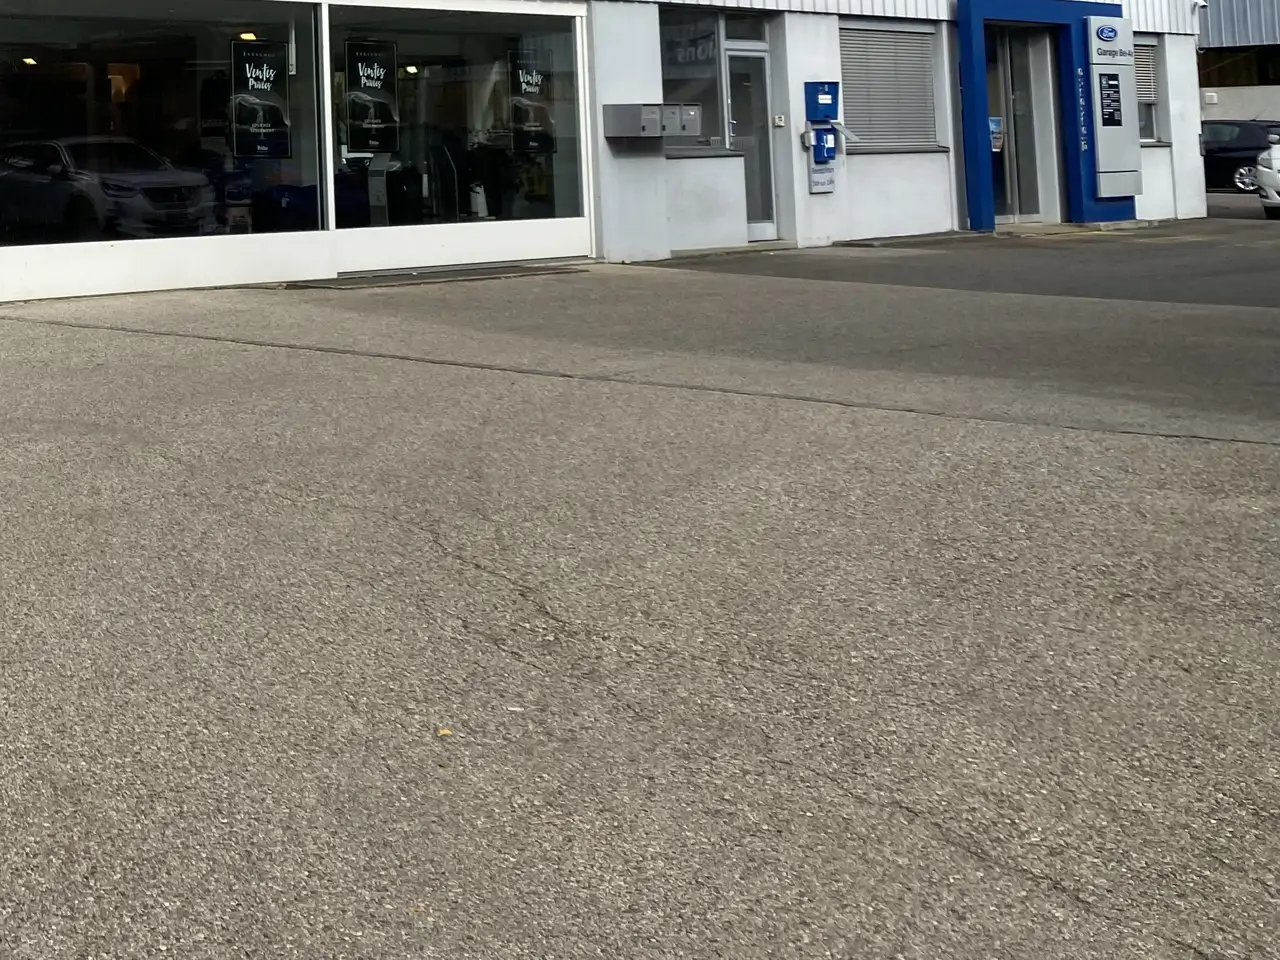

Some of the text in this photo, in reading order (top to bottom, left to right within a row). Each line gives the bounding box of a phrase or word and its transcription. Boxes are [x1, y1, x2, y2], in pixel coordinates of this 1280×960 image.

[1097, 47, 1119, 58] Garage
[245, 62, 277, 81] Ventes
[358, 62, 387, 80] Ventes
